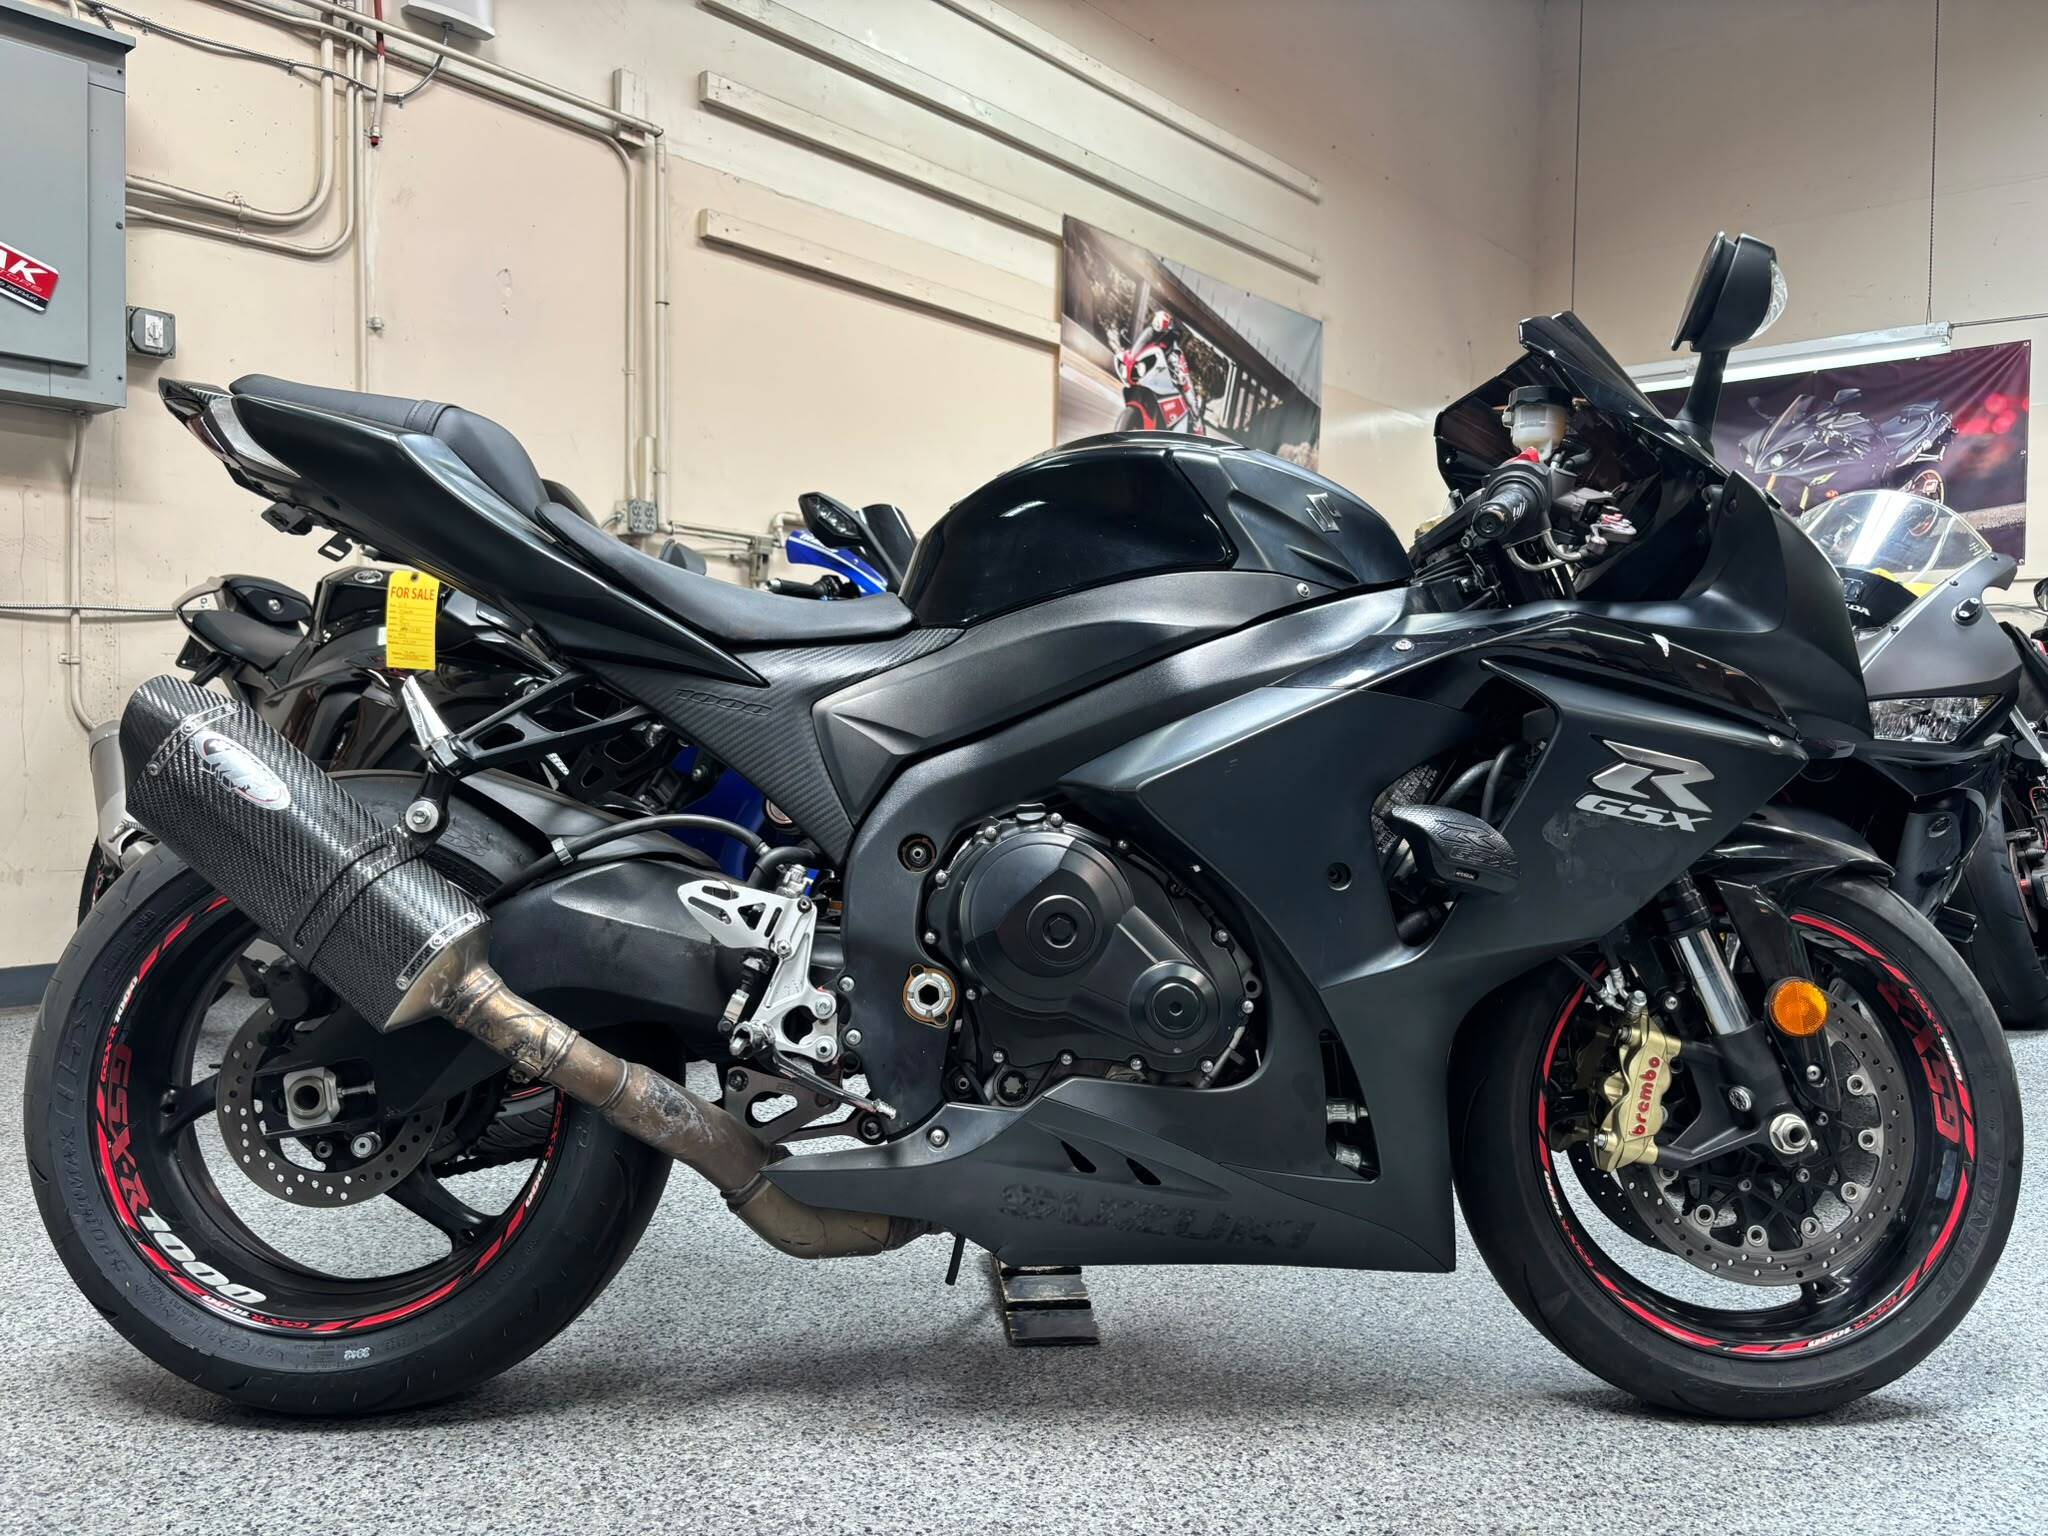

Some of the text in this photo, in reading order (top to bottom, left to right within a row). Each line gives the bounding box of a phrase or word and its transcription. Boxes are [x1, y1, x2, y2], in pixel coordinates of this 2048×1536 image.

[390, 586, 435, 601] FOR SALE
[1575, 794, 1713, 833] GSX
[1631, 1056, 1662, 1137] brembo
[107, 1043, 152, 1216] GSX-R
[139, 1207, 267, 1304] 1000
[1000, 1183, 1317, 1249] SUZUKI
[1935, 1152, 2002, 1306] DUNLOP
[201, 1294, 250, 1318] 1000
